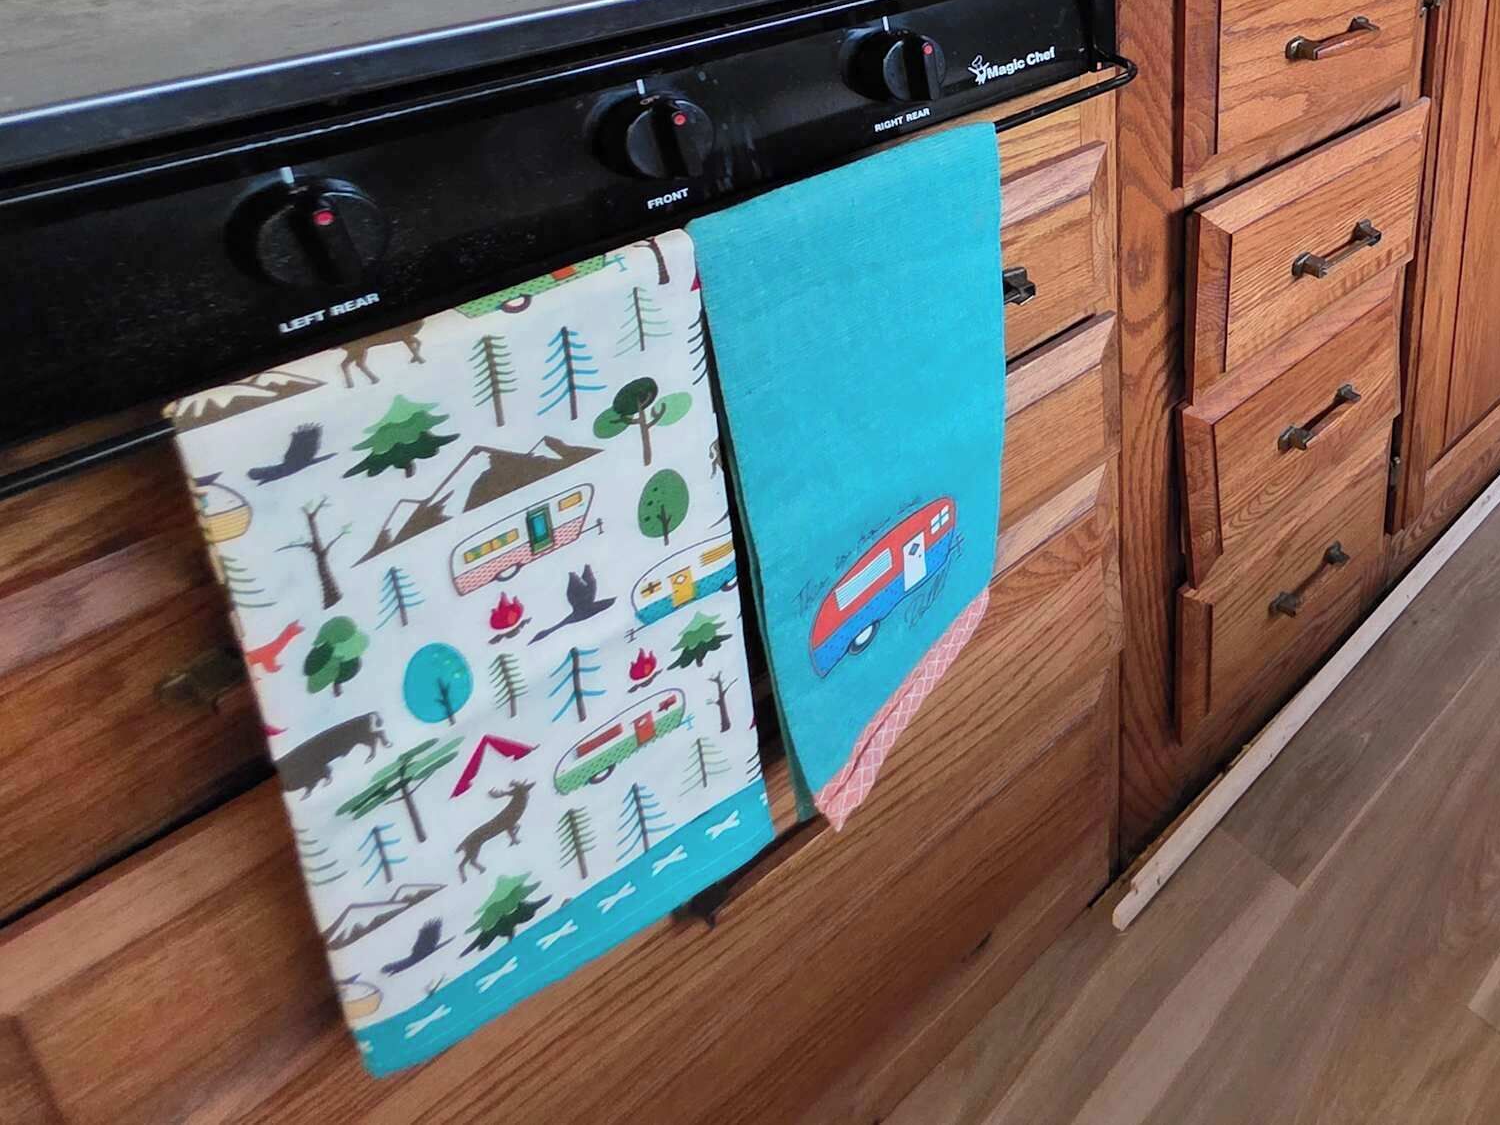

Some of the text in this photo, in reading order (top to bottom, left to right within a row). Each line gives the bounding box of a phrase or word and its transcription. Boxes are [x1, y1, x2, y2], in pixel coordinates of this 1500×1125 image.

[986, 46, 1056, 80] Magic Chef
[874, 107, 931, 133] RIGHT REAR
[647, 187, 689, 210] FRONT
[279, 292, 381, 334] LEFT REAR
